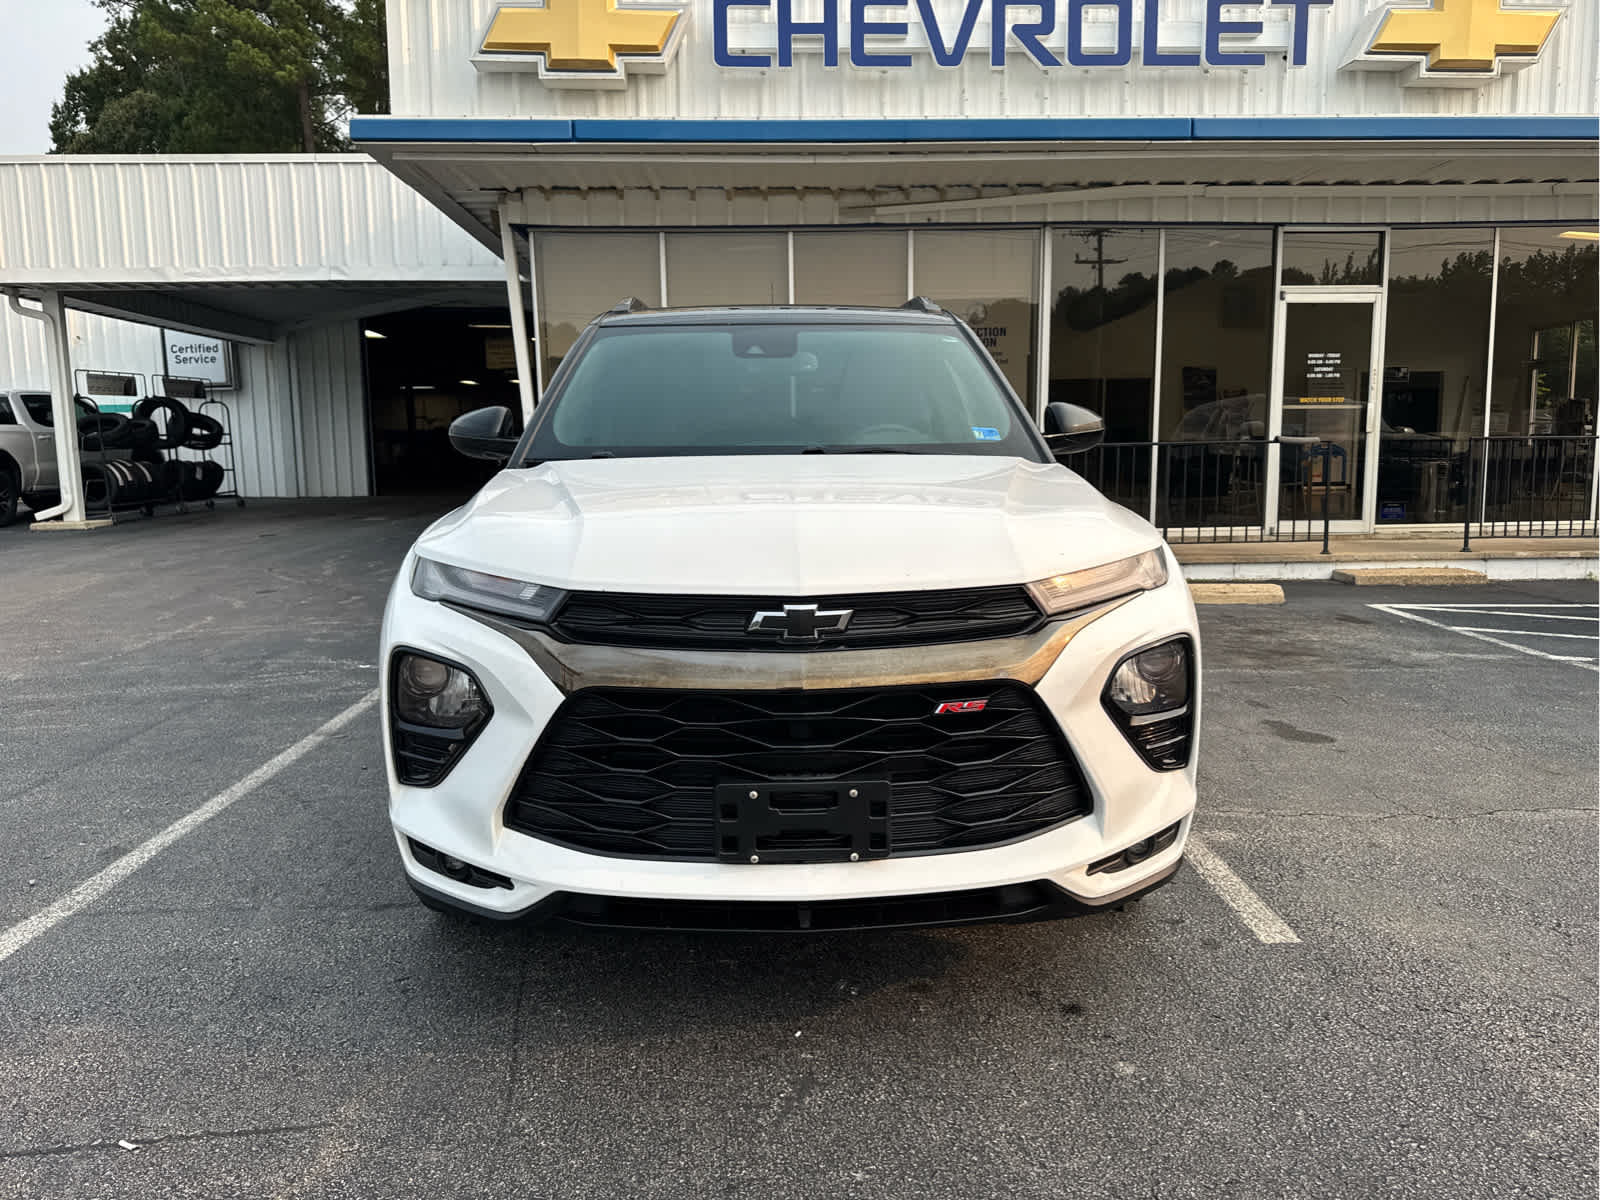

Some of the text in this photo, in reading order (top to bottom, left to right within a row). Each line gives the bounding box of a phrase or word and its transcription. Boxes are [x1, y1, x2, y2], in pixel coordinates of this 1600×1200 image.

[713, 0, 1334, 67] CHEVROLET
[170, 343, 219, 354] Certified
[174, 354, 217, 364] Service
[934, 699, 989, 714] RS
